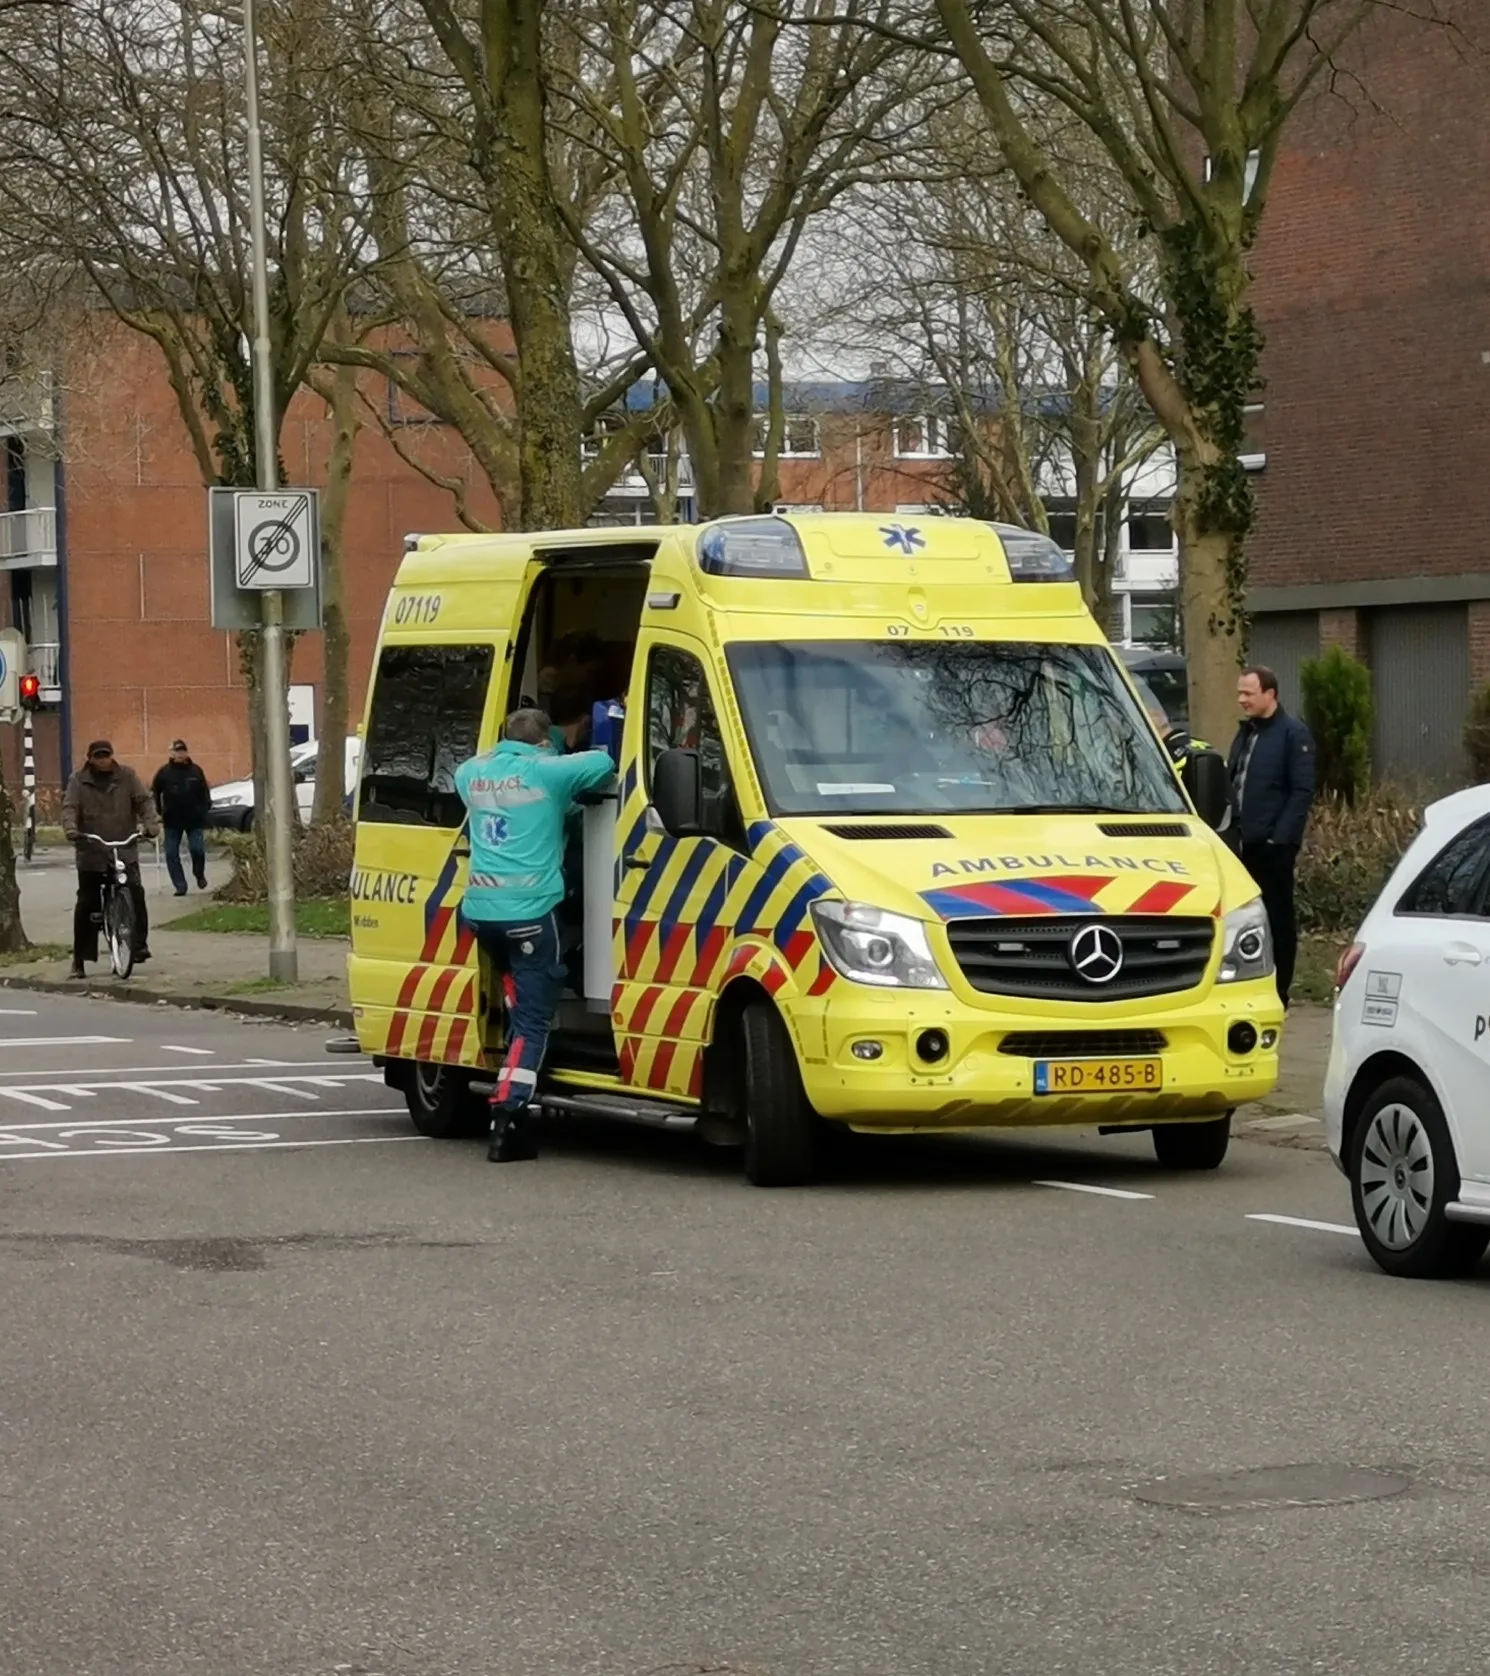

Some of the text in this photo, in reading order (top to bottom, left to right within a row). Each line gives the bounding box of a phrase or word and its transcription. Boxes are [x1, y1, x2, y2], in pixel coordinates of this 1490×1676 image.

[258, 500, 288, 508] ZONE
[395, 595, 441, 624] 07119
[887, 625, 974, 637] 07 119
[932, 855, 1191, 877] AMBULANCE
[1054, 1064, 1156, 1086] RD-485-B
